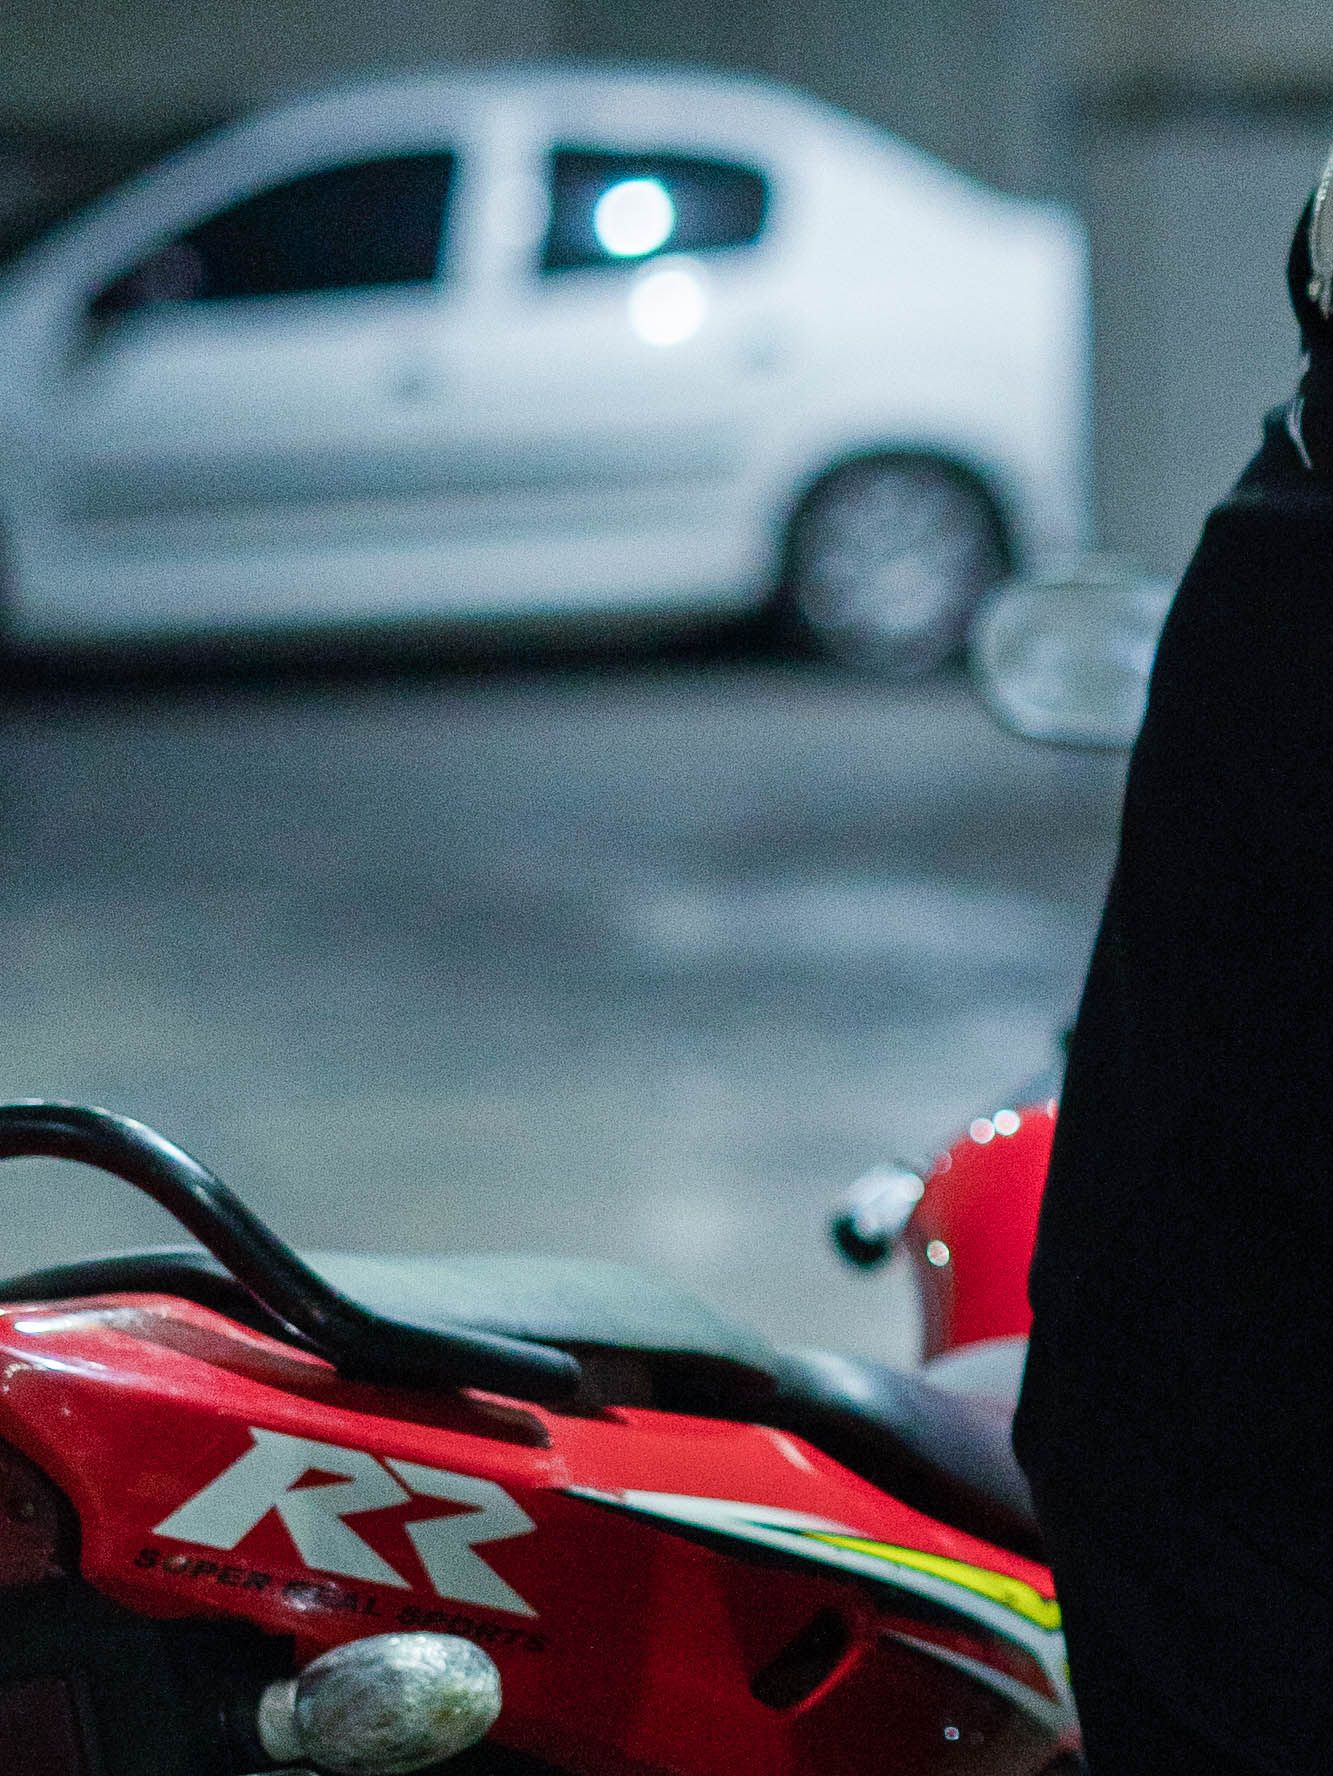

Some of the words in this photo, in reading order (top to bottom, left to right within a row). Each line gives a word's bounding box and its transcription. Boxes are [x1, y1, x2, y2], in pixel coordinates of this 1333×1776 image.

[151, 1425, 541, 1620] RR
[132, 1546, 273, 1592] SUPER
[393, 1604, 548, 1654] SPORTS
